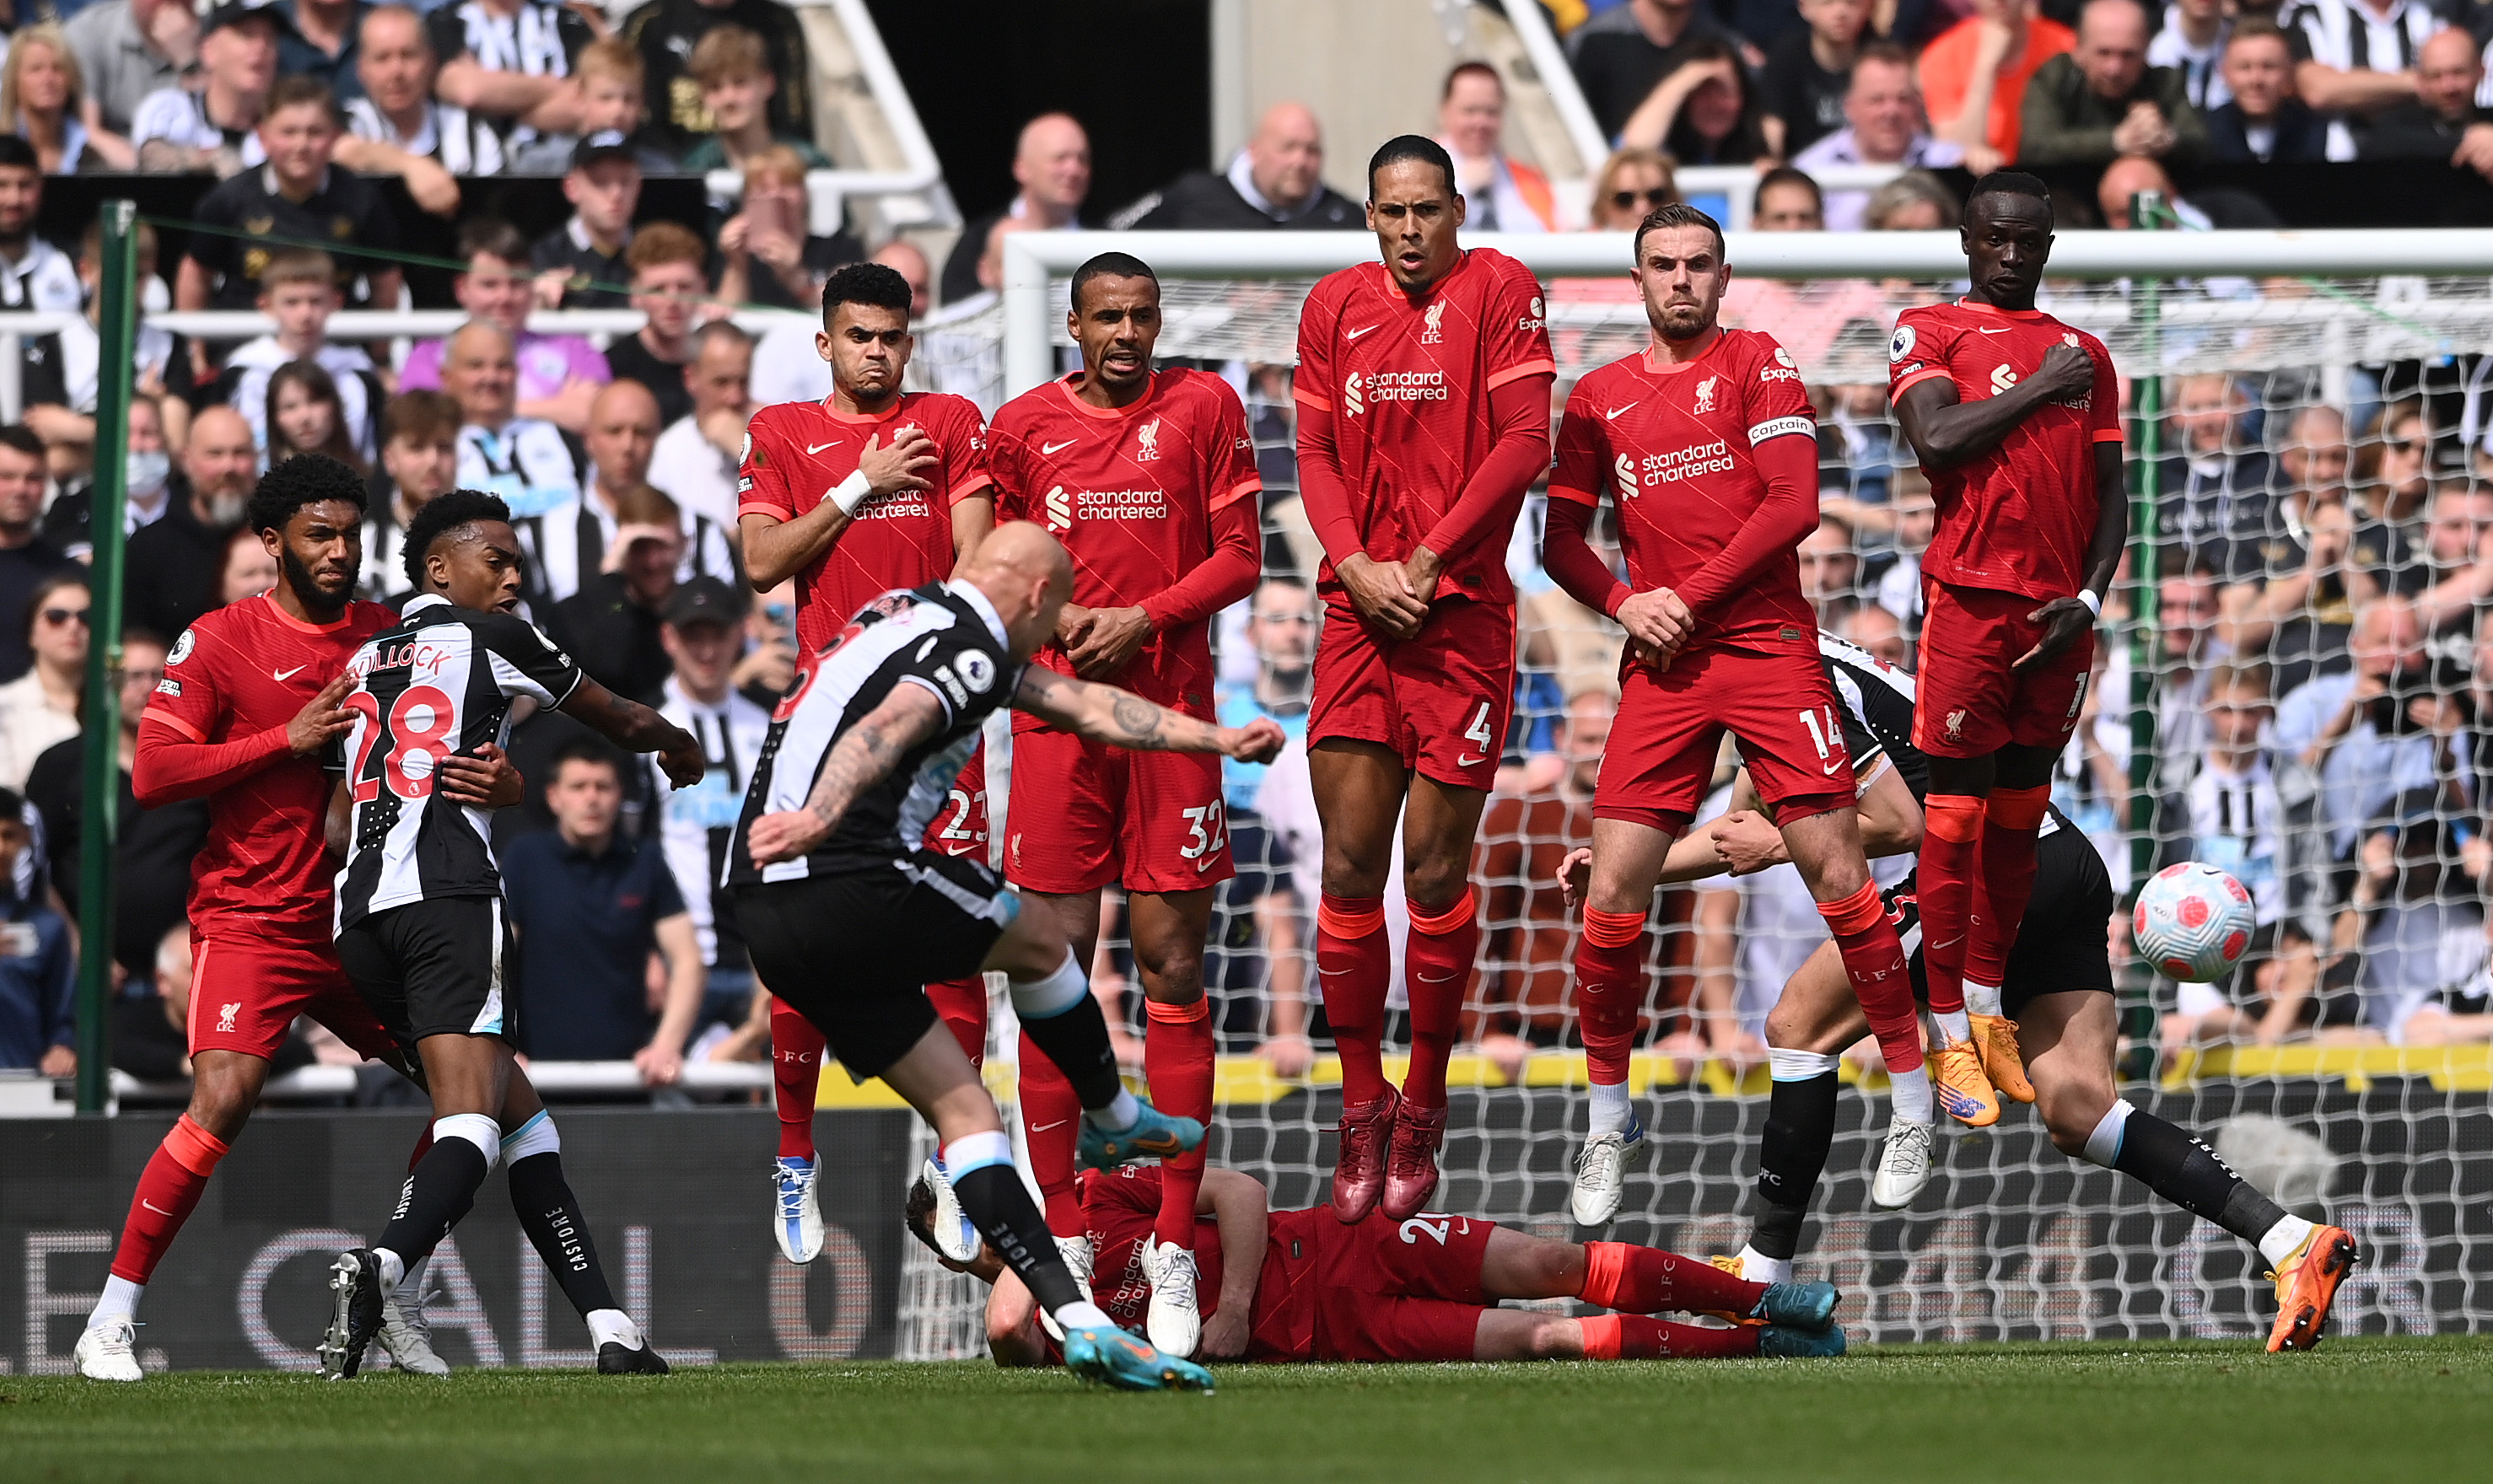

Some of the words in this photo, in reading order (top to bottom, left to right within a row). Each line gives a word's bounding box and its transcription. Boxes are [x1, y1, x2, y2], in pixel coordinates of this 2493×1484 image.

[1365, 369, 1443, 390] standard
[1369, 384, 1448, 403] chartered
[1751, 420, 1808, 440] Captain
[1641, 438, 1726, 472] standard
[1645, 454, 1735, 487] chartered
[853, 503, 929, 521] chartered
[1077, 488, 1163, 506] standard
[1078, 503, 1167, 521] chartered
[341, 685, 456, 803] 28
[1464, 702, 1492, 754] 4
[1798, 704, 1847, 760] 14
[940, 789, 990, 842] 23
[1180, 798, 1225, 858] 32
[1575, 974, 1605, 995] FC
[1854, 954, 1904, 984] LFC
[544, 1206, 589, 1272] CASTORE
[1399, 1212, 1455, 1247] 2
[1109, 1237, 1146, 1315] standard
[1660, 1258, 1677, 1304] LFC
[235, 1227, 719, 1374] CALL
[1123, 1271, 1150, 1320] chart
[1658, 1328, 1672, 1357] FC
